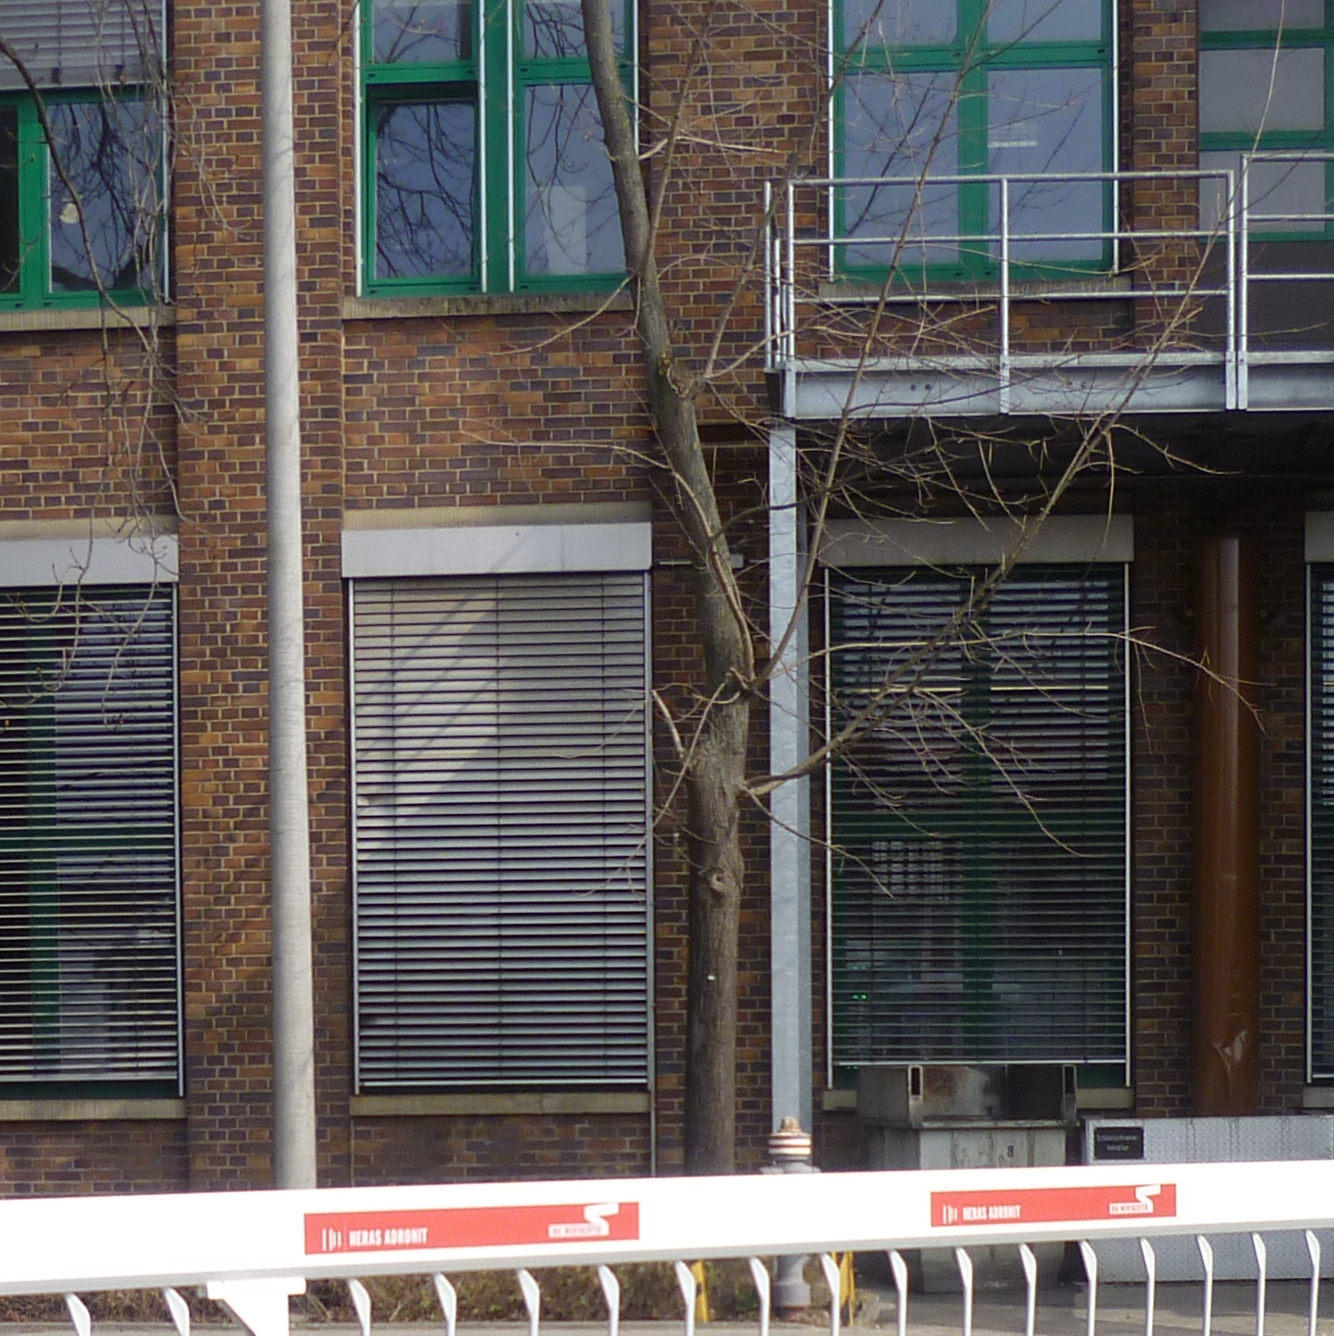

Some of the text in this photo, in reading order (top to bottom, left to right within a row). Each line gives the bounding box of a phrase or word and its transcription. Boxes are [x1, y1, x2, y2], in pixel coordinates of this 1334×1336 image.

[963, 1206, 987, 1221] HERAS
[349, 1227, 428, 1246] HERAS ADRONIT
